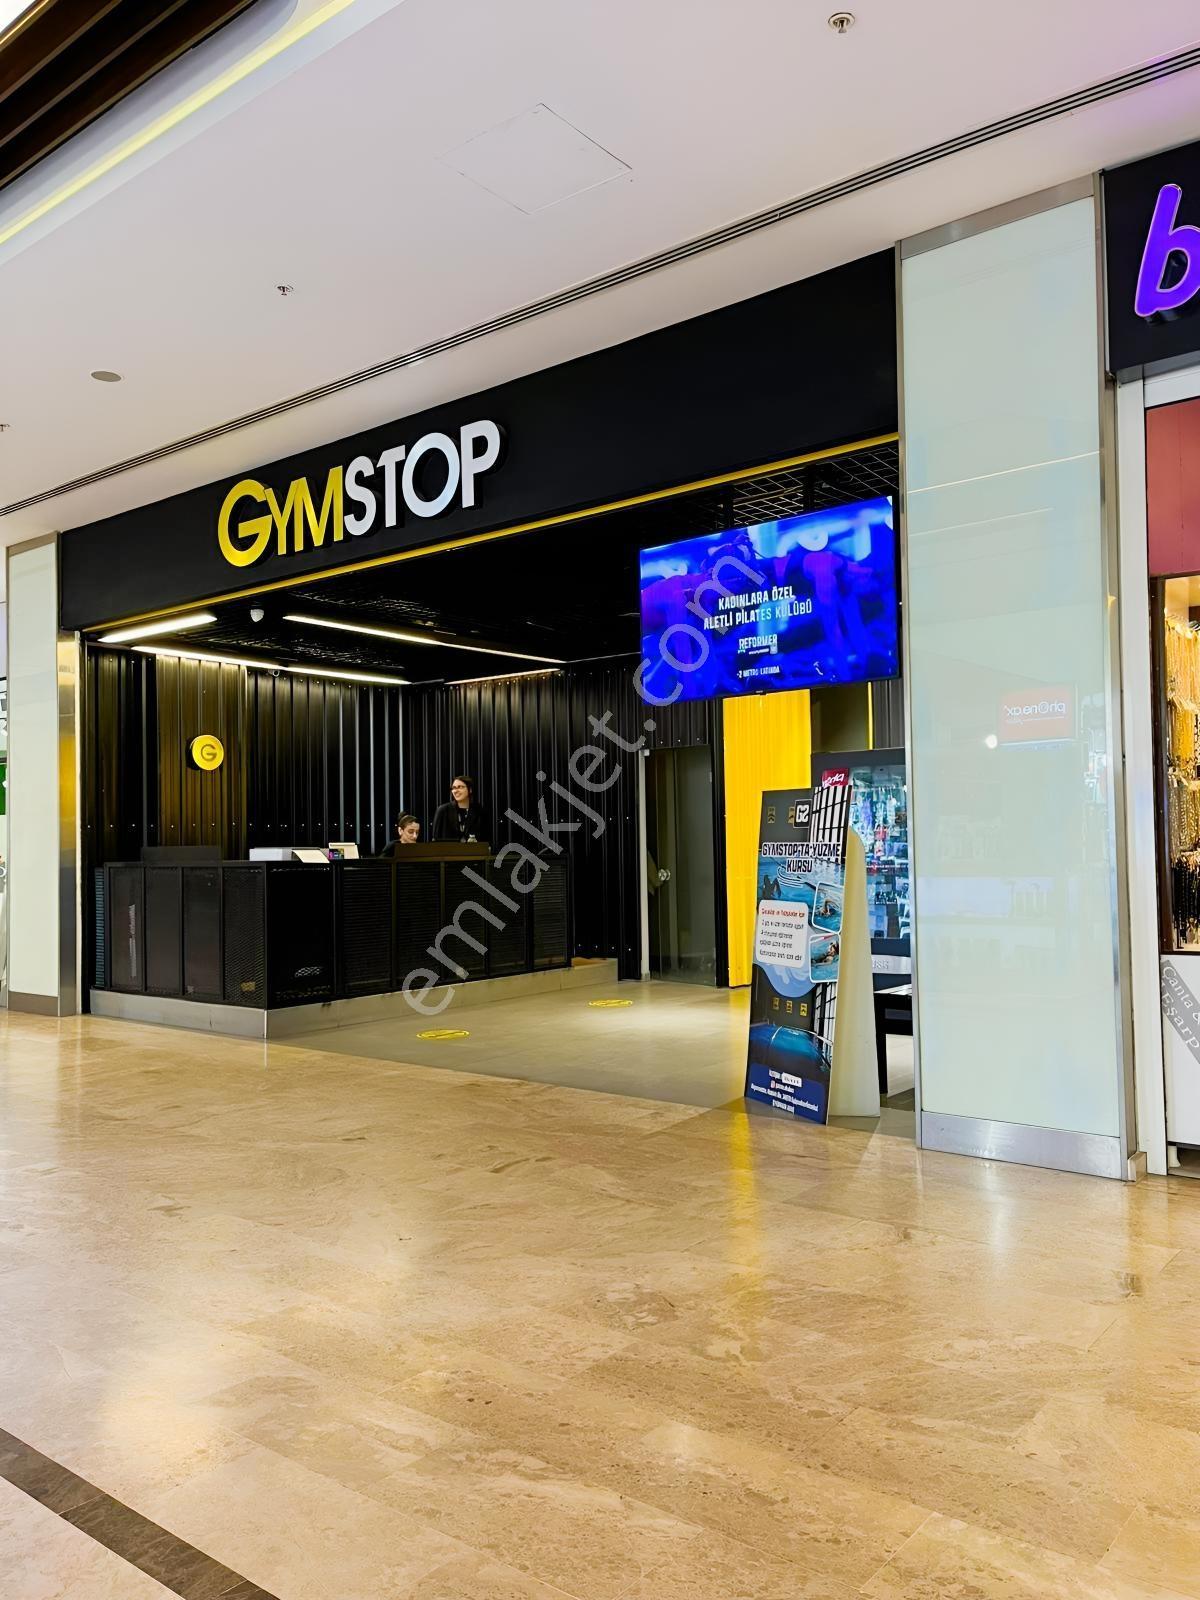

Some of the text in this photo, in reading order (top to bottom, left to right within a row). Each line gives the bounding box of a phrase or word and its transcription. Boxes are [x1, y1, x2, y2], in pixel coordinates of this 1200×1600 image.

[217, 419, 500, 567] GYMSTOP
[718, 585, 795, 611] KADINLARA ÖZEL
[704, 598, 812, 630] ALETLİ PİLATES KULÜBÜ
[738, 633, 778, 649] REFORMER
[201, 744, 217, 762] G
[812, 840, 841, 858] YÜZME
[786, 859, 813, 873] KURSU
